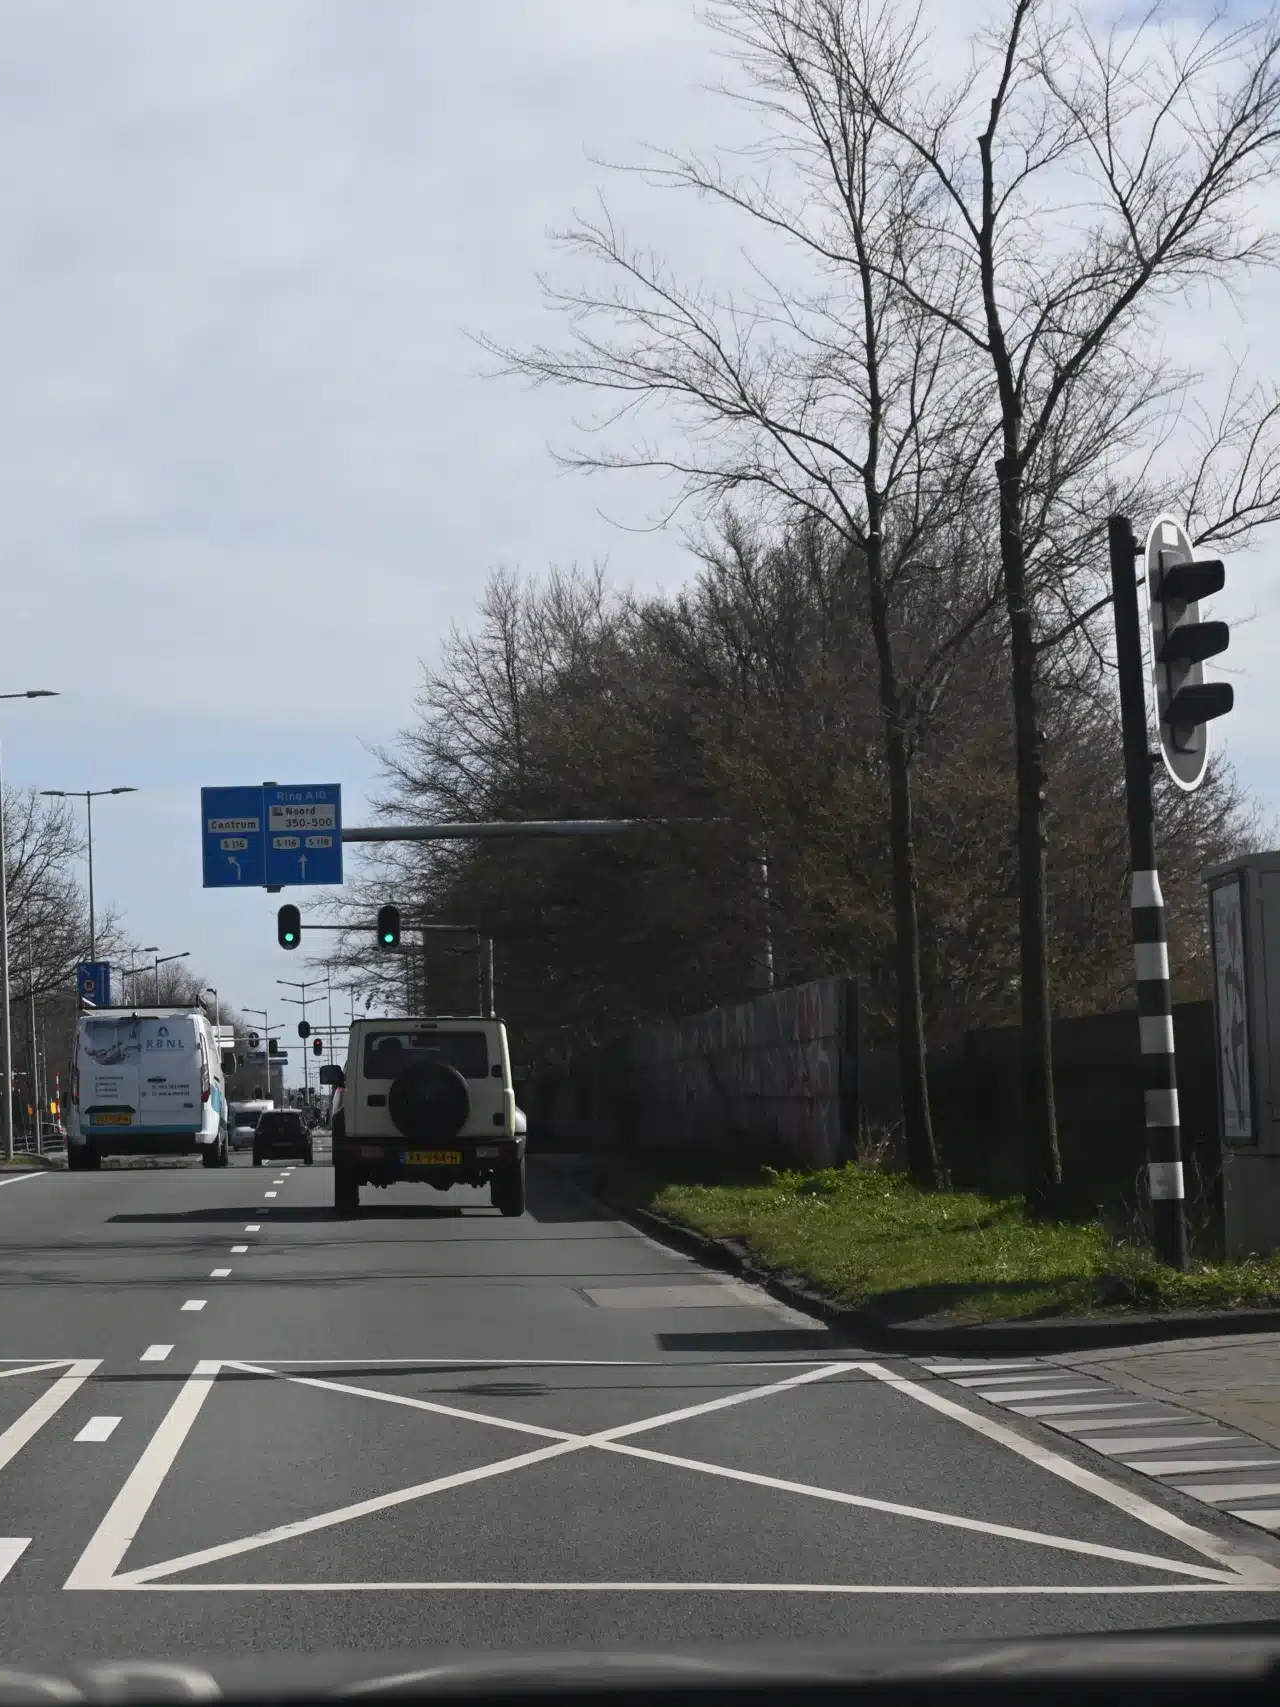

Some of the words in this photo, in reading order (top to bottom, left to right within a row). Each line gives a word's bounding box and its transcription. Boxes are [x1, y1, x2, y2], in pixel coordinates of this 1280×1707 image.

[276, 791, 302, 801] Ring
[305, 790, 327, 800] A10
[285, 806, 316, 815] Noord
[211, 819, 257, 829] Centrum
[285, 817, 333, 828] 350-500
[232, 840, 245, 849] 116
[284, 839, 297, 847] 116
[146, 1040, 185, 1049] RBNL
